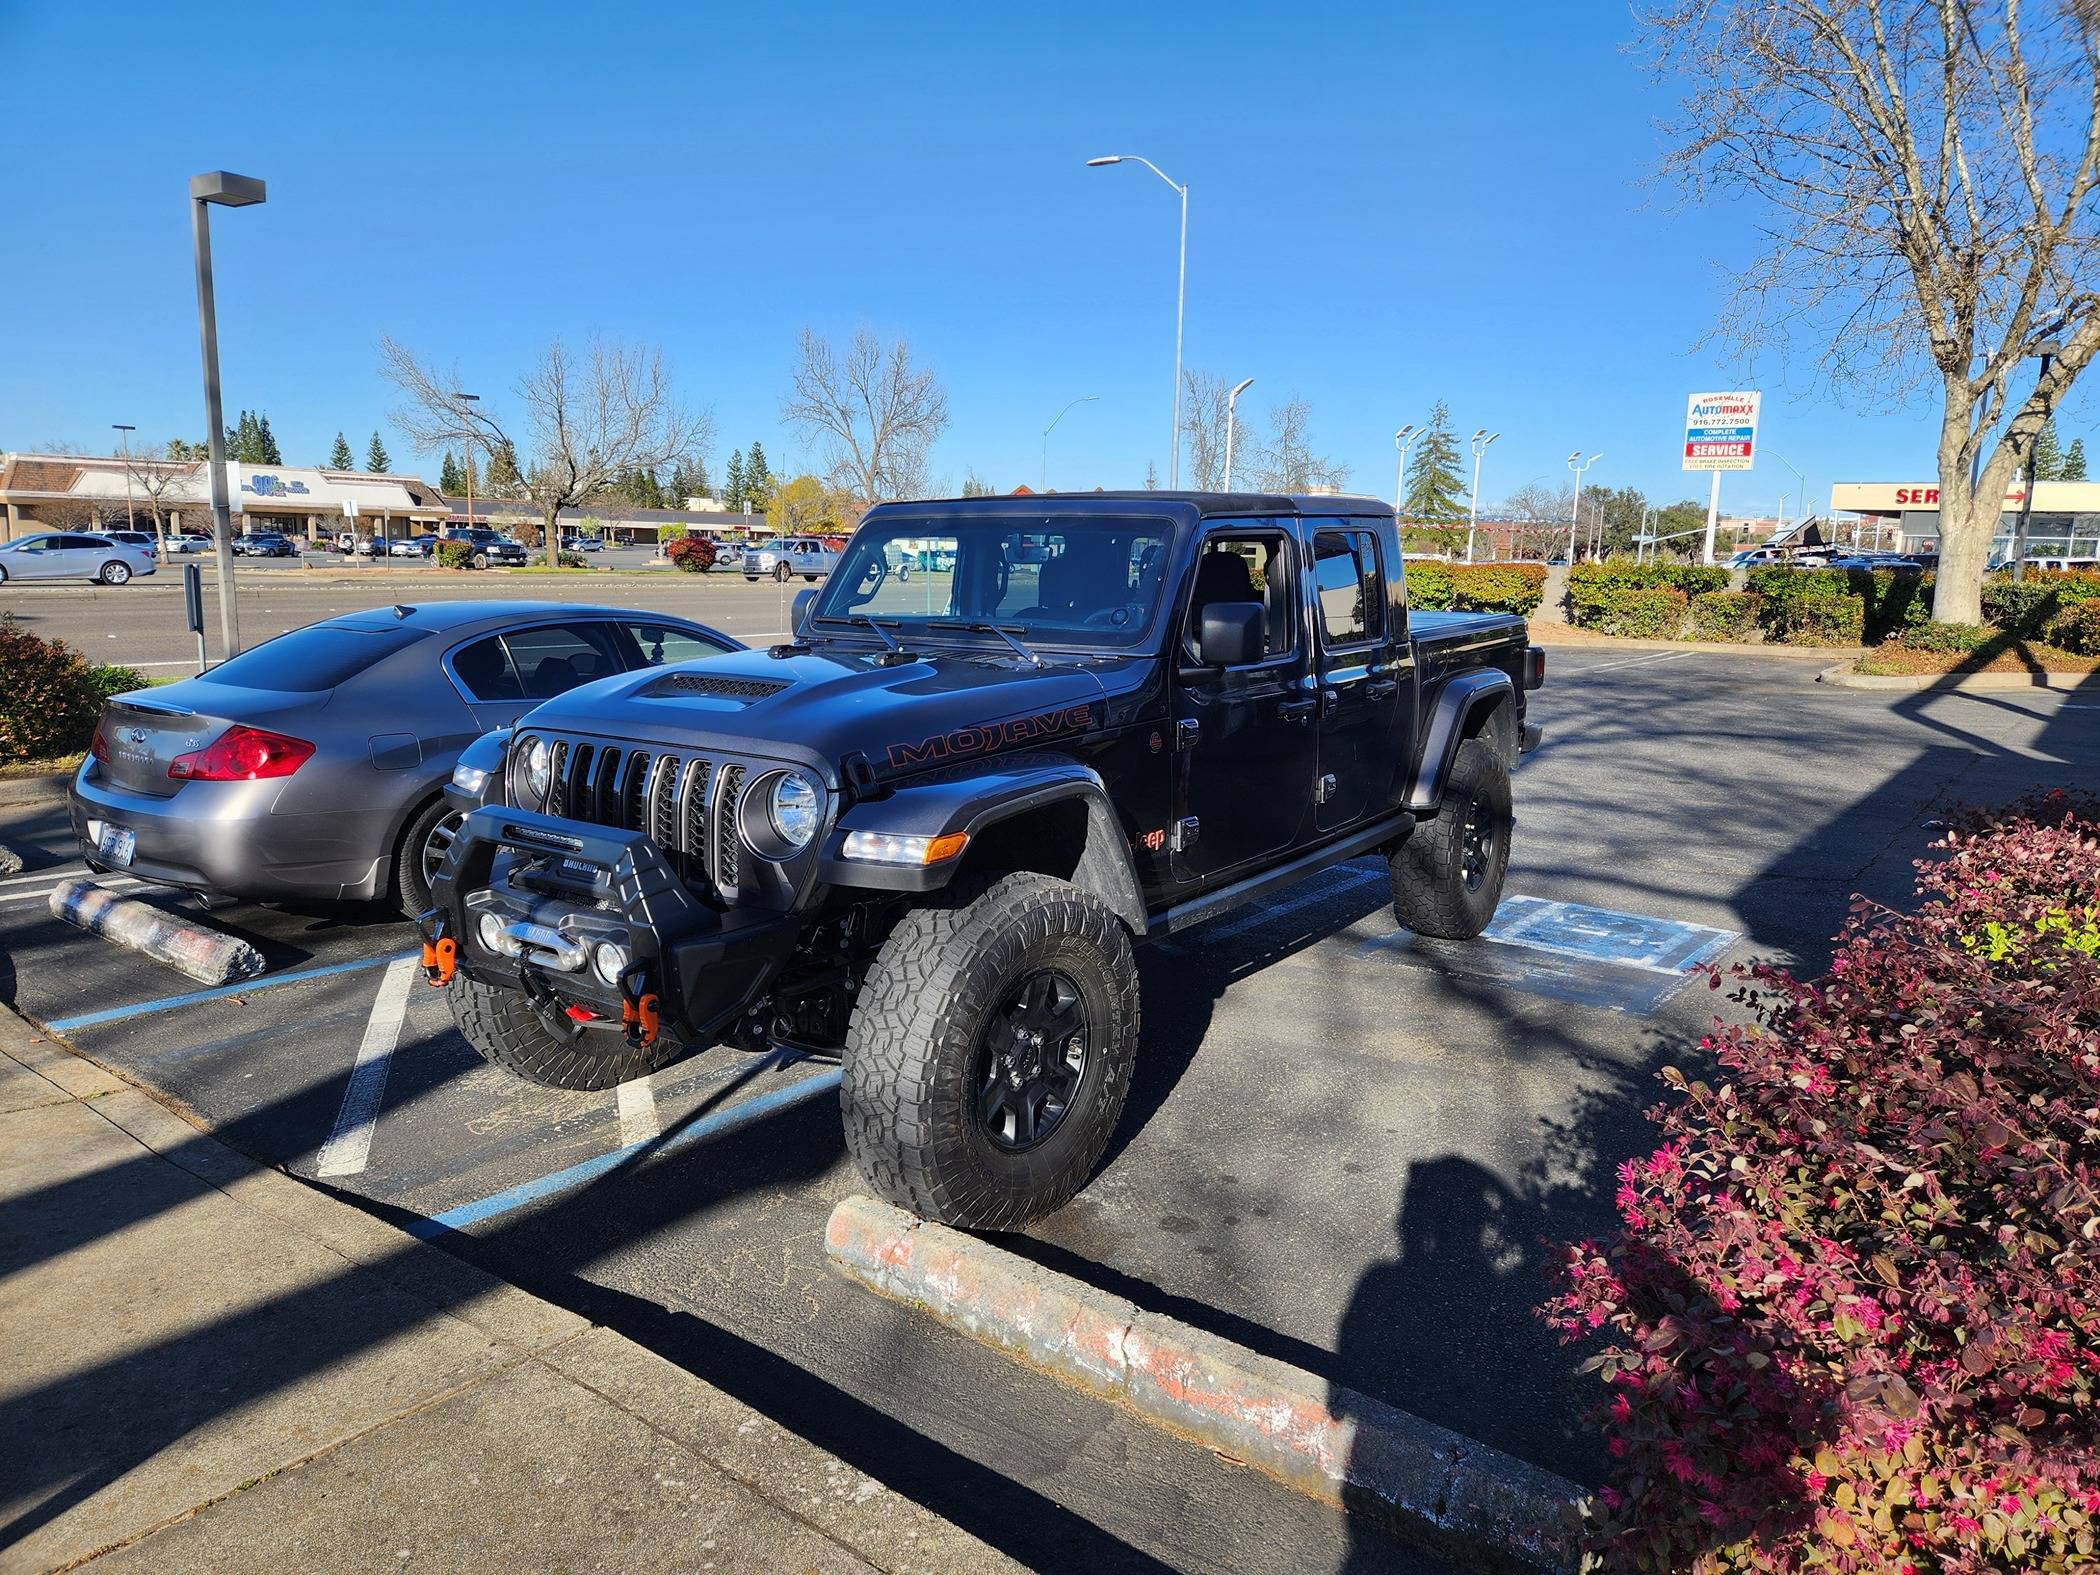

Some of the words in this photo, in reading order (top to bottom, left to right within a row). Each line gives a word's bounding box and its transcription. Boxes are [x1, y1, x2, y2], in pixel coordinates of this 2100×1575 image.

[1693, 418, 1750, 426] 916.772.7500
[1692, 444, 1745, 456] SERVICE
[1894, 489, 1940, 505] SER
[886, 704, 1093, 768] MOJAVE
